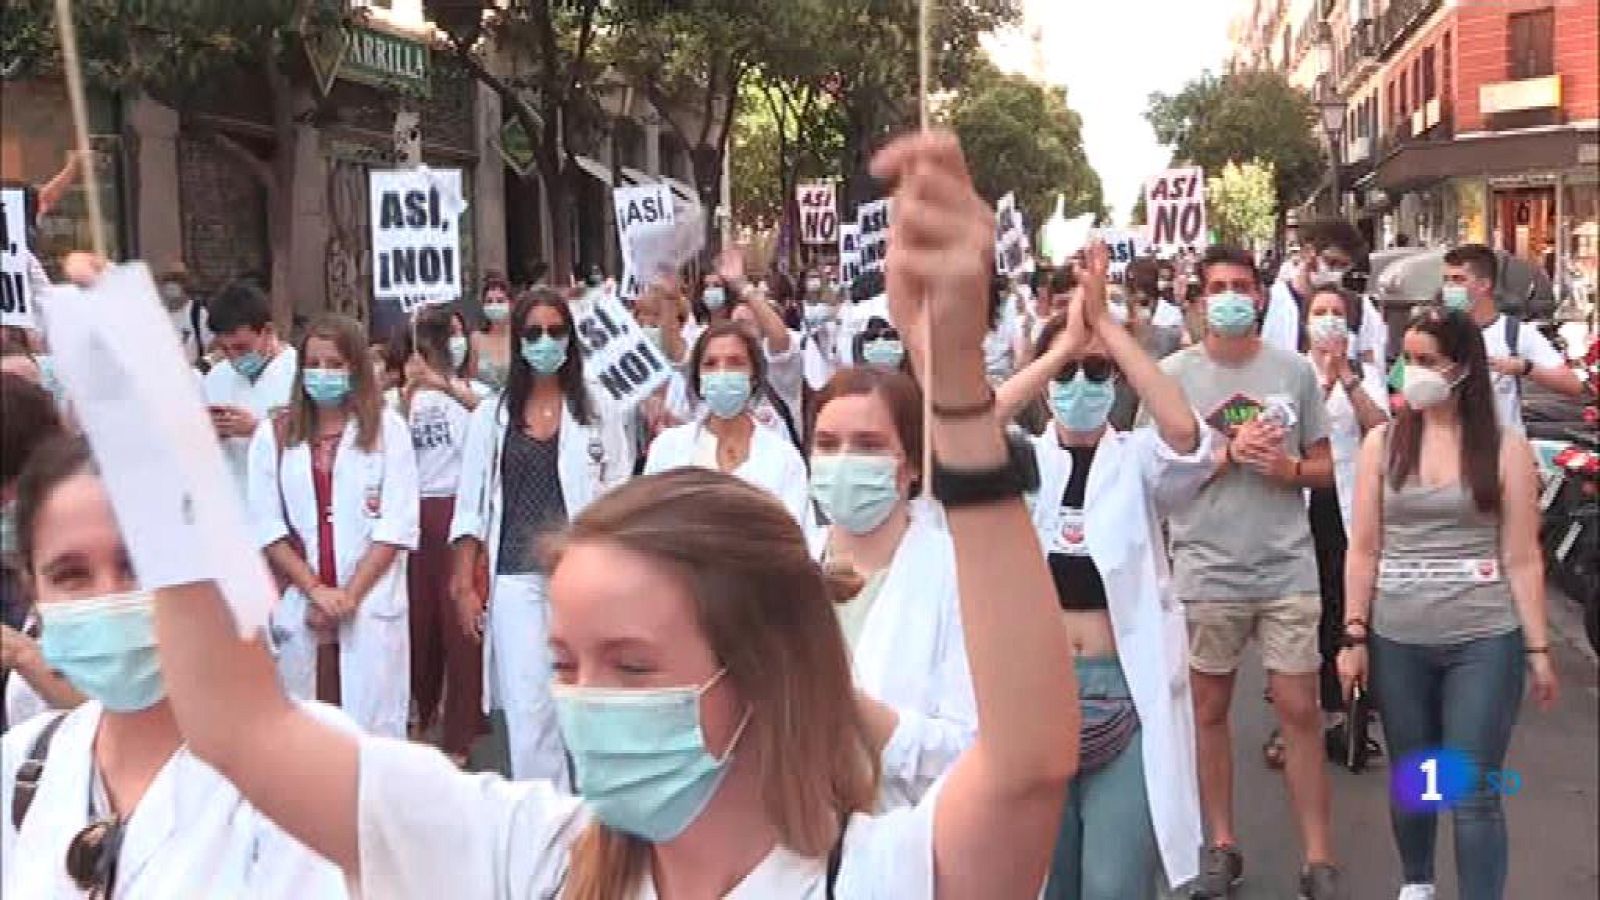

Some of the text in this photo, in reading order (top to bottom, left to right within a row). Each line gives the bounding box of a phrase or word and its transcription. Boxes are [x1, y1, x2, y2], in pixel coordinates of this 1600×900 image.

[805, 211, 835, 239] NO
[1153, 202, 1202, 245] NO
[378, 247, 455, 289] ¡NO!
